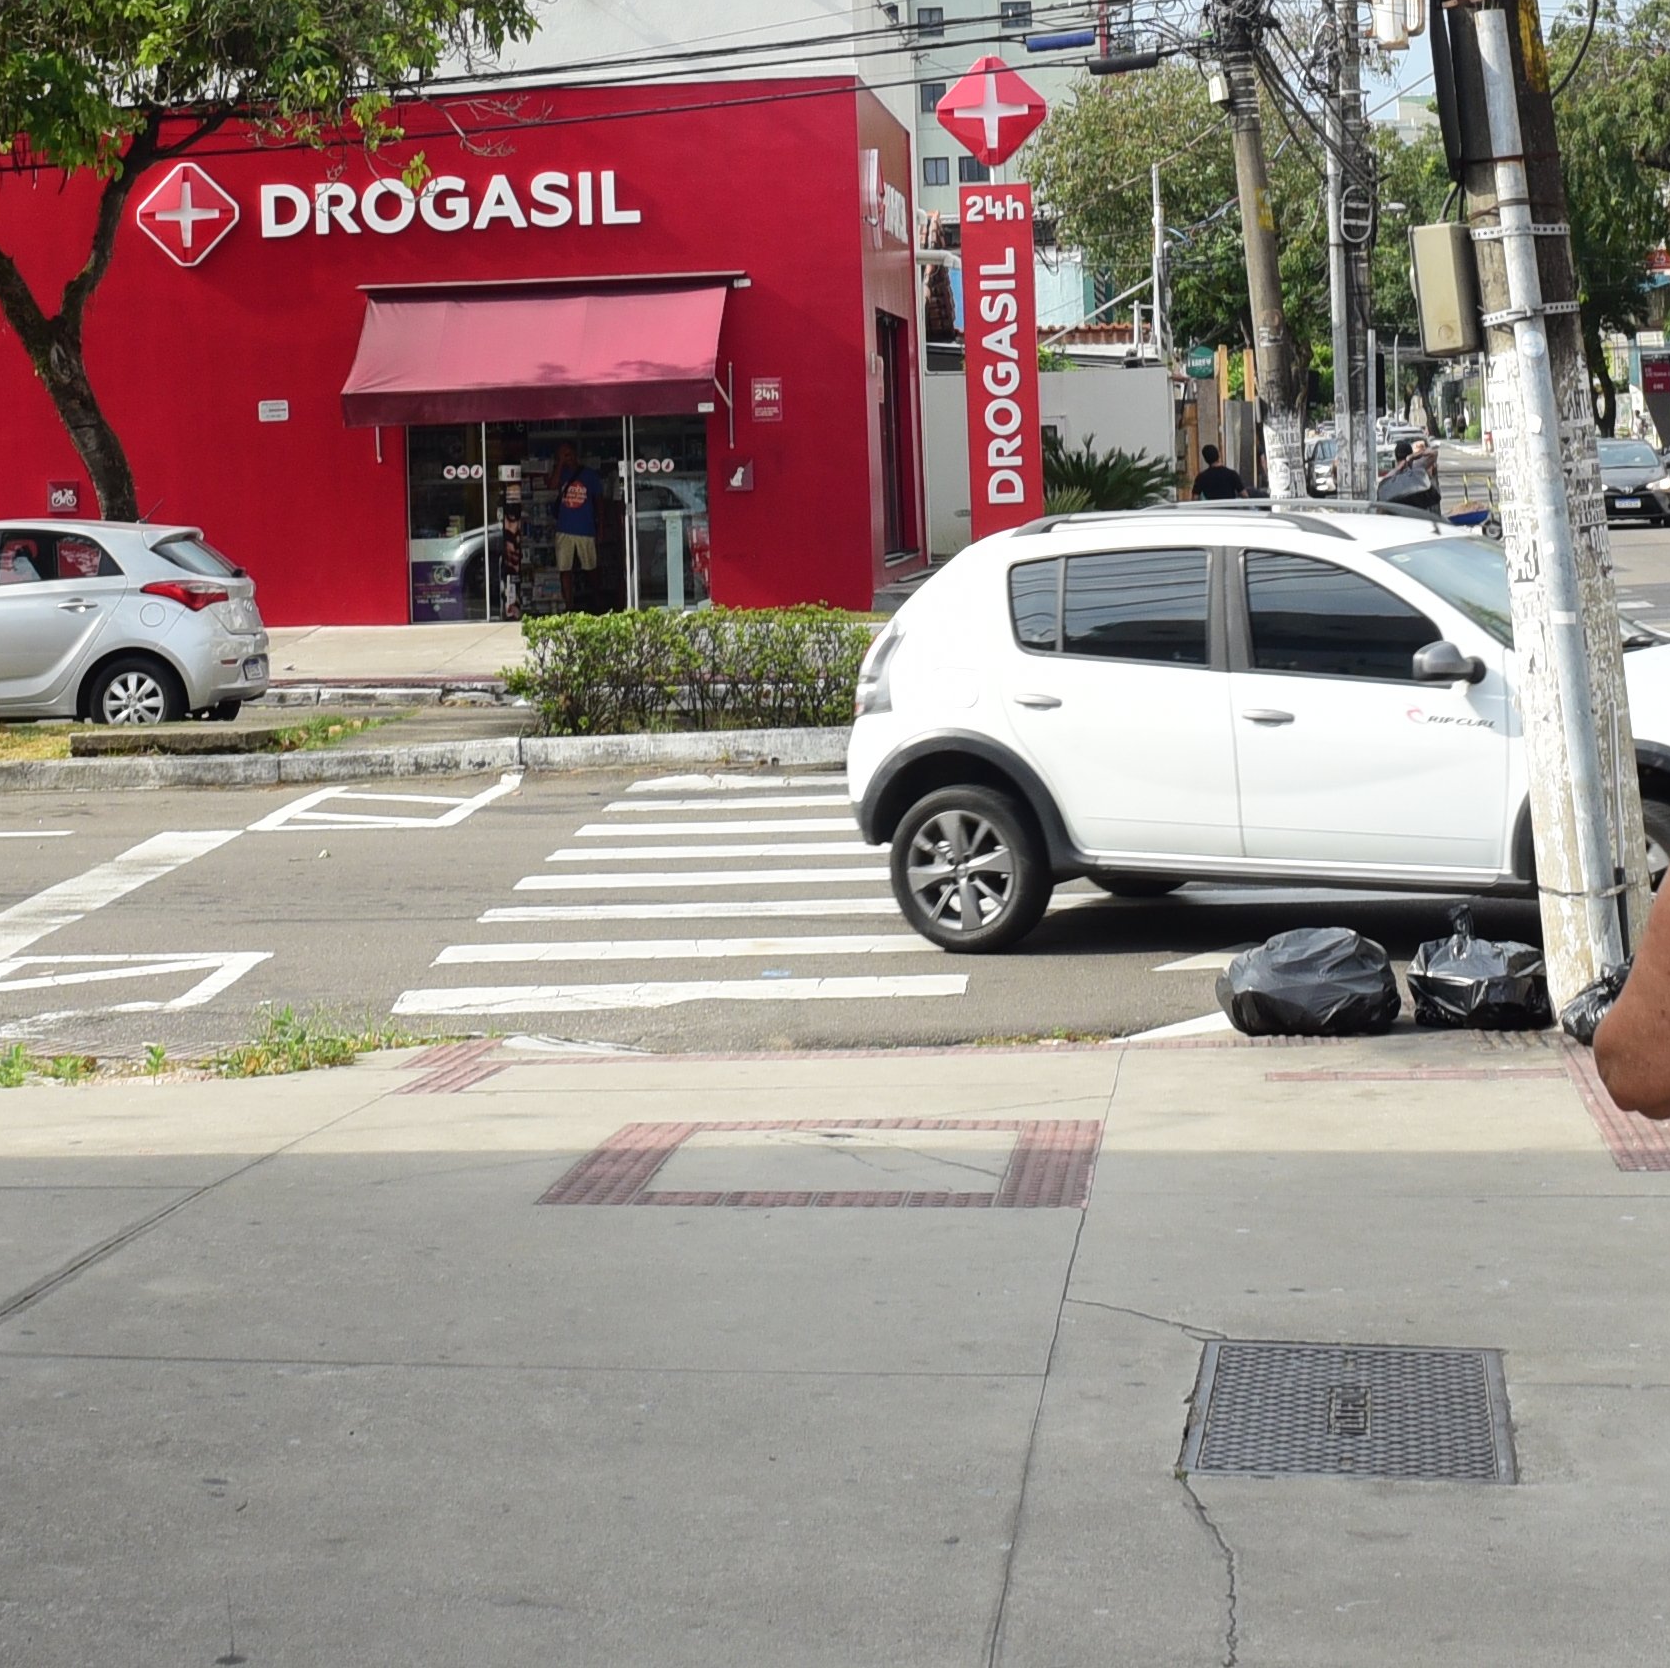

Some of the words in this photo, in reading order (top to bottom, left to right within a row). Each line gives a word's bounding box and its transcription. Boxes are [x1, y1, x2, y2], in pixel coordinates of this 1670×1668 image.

[259, 170, 641, 238] DROGASIL
[965, 194, 1024, 224] 24h
[979, 247, 1025, 505] DROGASIL
[754, 388, 779, 401] 24h
[1427, 715, 1454, 724] RIP
[1456, 717, 1495, 729] CURL
